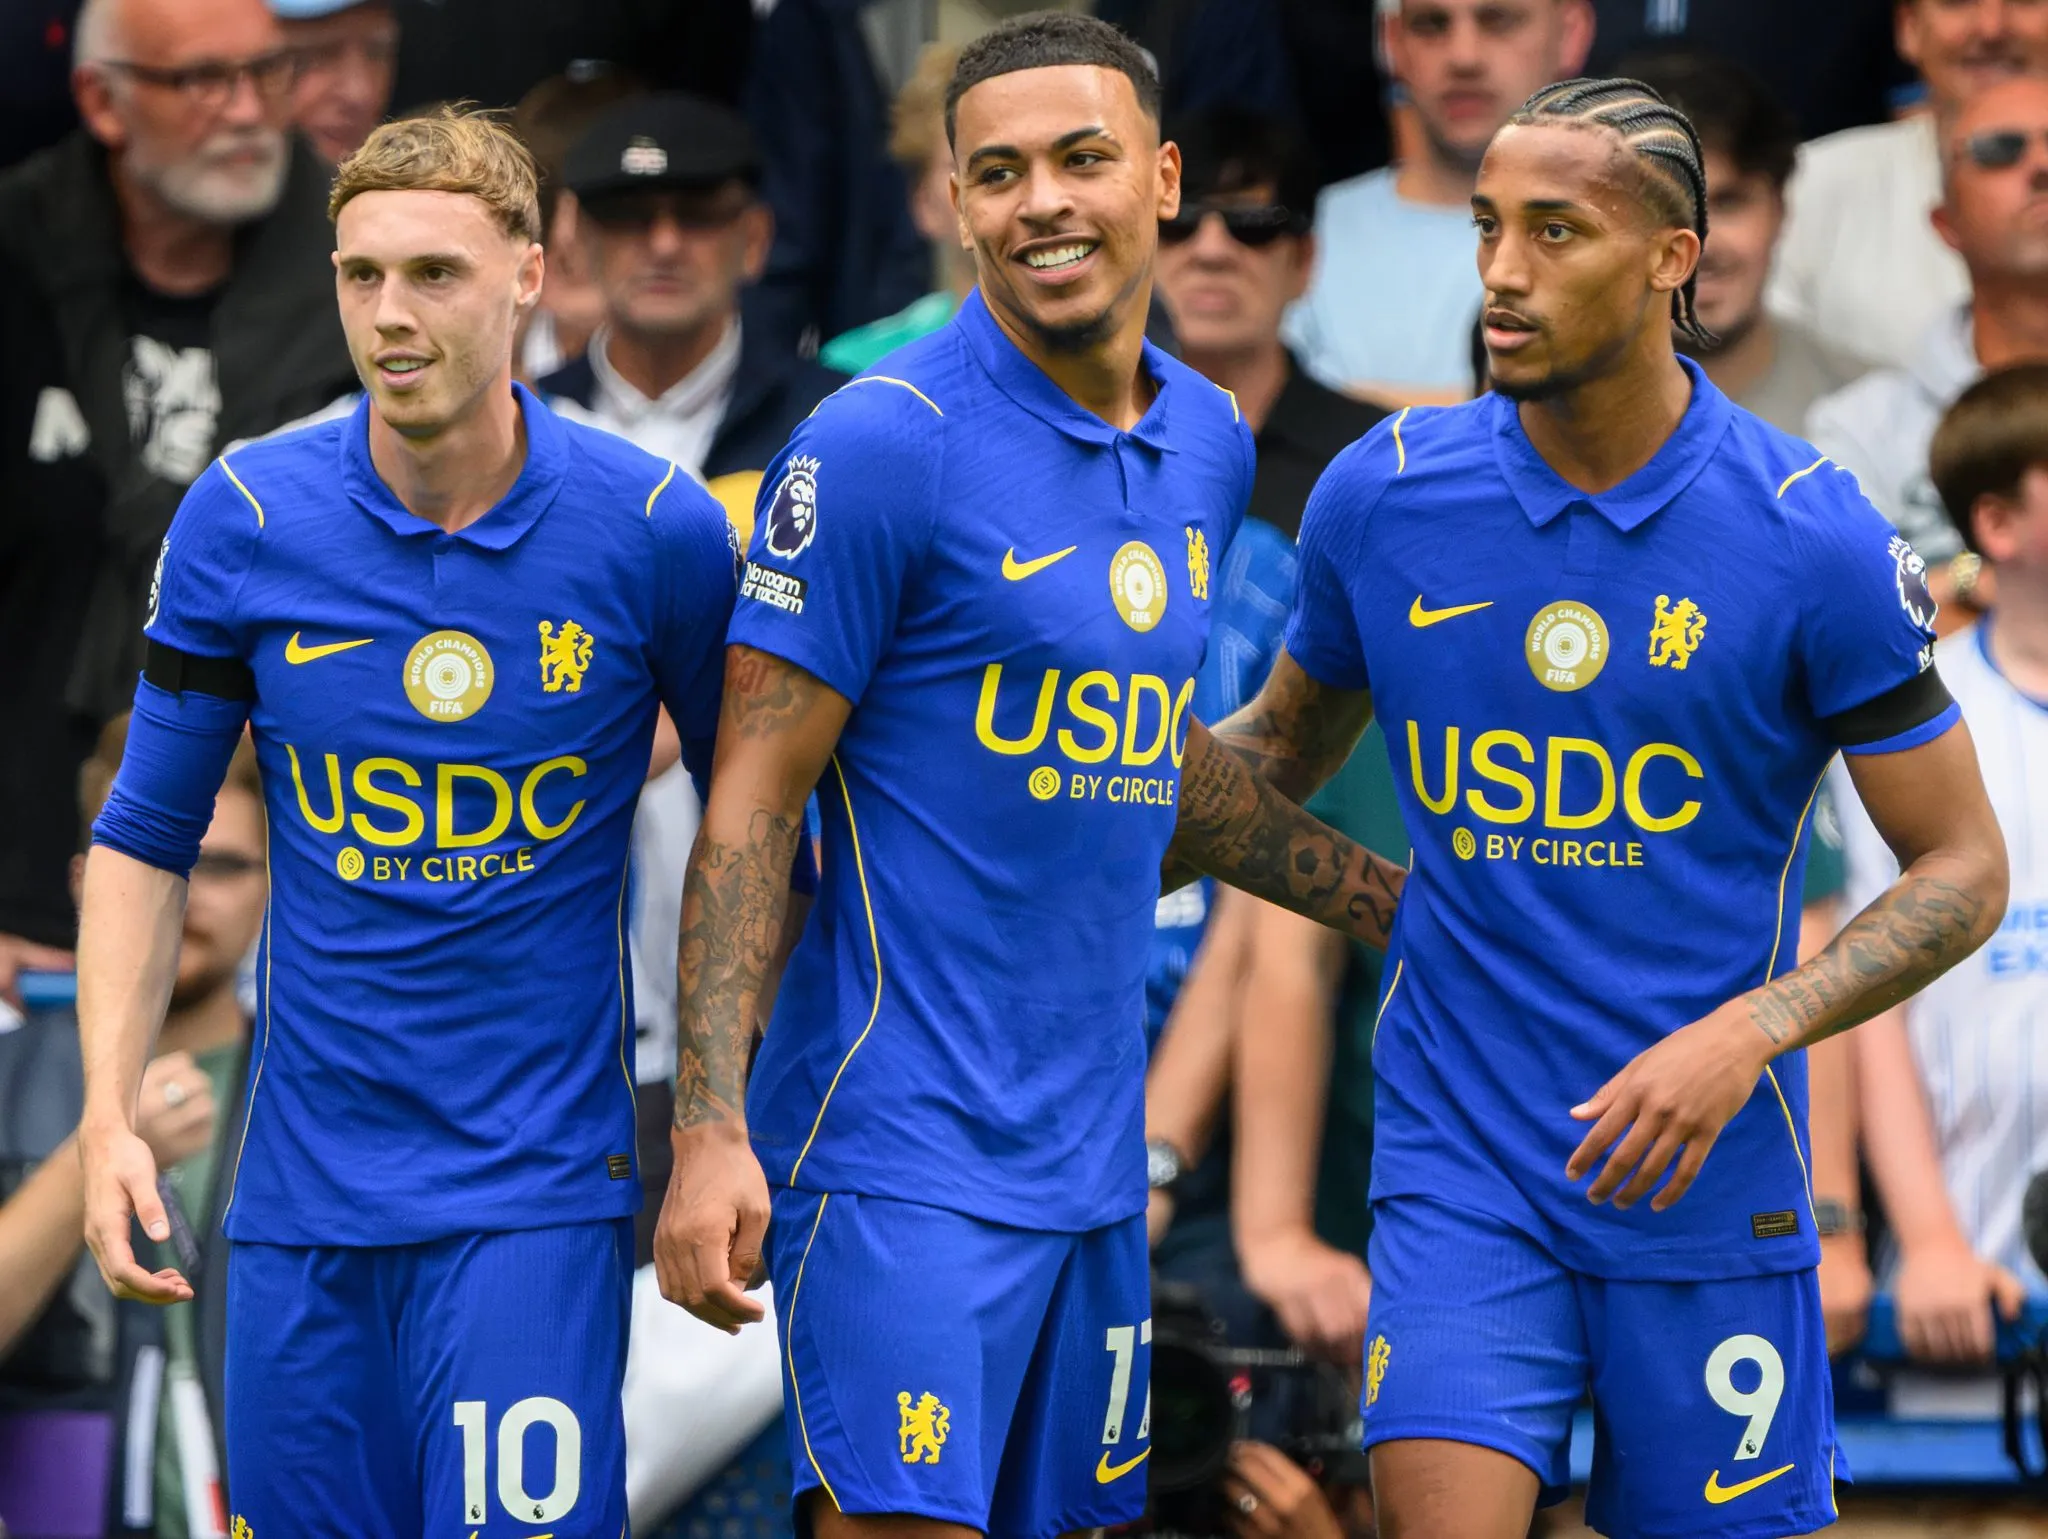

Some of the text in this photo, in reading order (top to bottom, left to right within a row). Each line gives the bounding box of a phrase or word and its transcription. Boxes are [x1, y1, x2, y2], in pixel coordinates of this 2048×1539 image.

[746, 561, 801, 597] No room
[755, 584, 803, 614] racism
[1130, 610, 1152, 624] FIFA
[1532, 608, 1601, 660] WORLD CHAMPIONS
[411, 639, 485, 688] WORLD CHAMPIONS
[1546, 668, 1577, 684] FIFA
[430, 700, 464, 714] FIFA
[975, 663, 1196, 769] USDC
[1070, 774, 1102, 799] BY
[1107, 776, 1174, 805] CIRCLE
[1406, 719, 1704, 832] USDC
[285, 743, 588, 848] USDC
[373, 857, 412, 880] BY
[421, 847, 536, 882] CIRCLE
[1486, 834, 1525, 860] BY
[1531, 838, 1644, 866] CIRCLE
[1705, 1334, 1785, 1460] 9
[453, 1396, 582, 1525] 10
